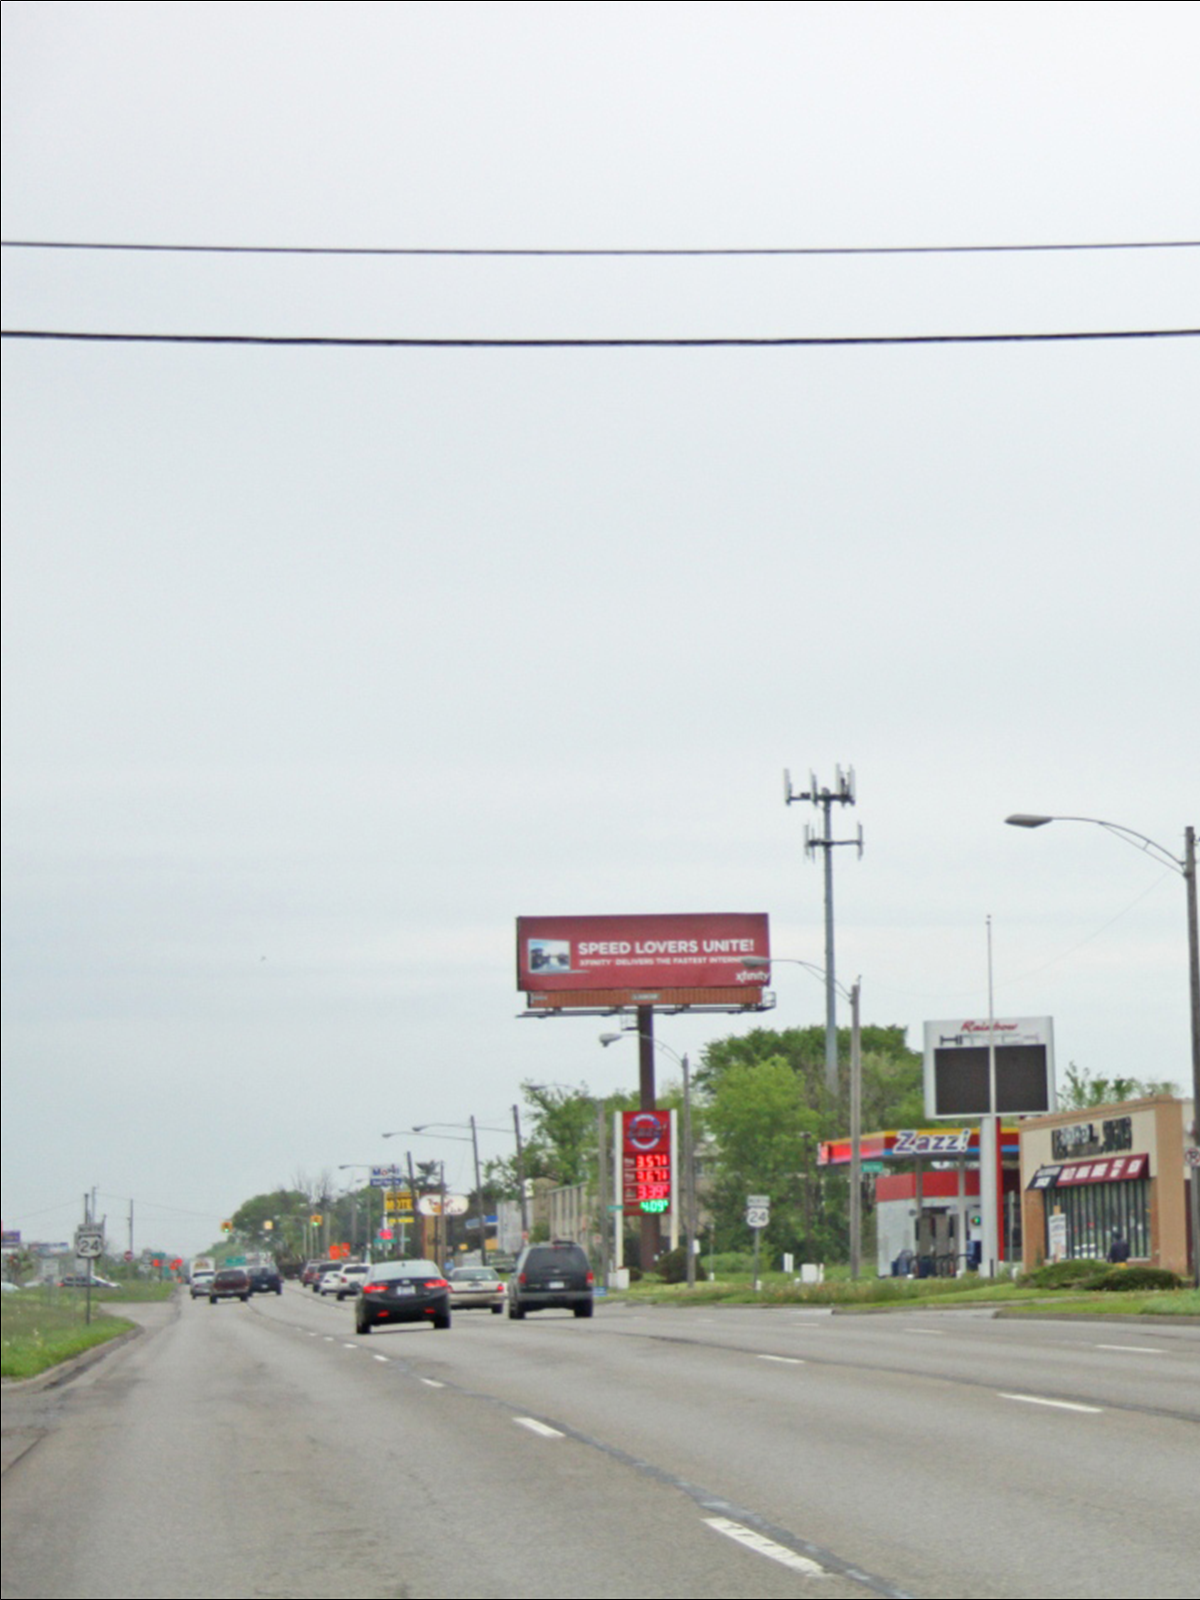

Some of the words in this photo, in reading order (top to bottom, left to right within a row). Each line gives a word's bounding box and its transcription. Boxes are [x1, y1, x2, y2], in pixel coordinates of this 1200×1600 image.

[578, 941, 631, 956] SPEED
[635, 940, 698, 954] LOVERS
[702, 939, 755, 953] UNITE!
[615, 958, 654, 966] DELIVERS
[656, 957, 671, 965] THE
[673, 957, 707, 965] FASTEST
[709, 956, 744, 964] INTERNE
[735, 970, 770, 984] xfinity
[893, 1128, 971, 1153] Zazz!
[749, 1211, 766, 1223] 24
[80, 1240, 99, 1253] 24
